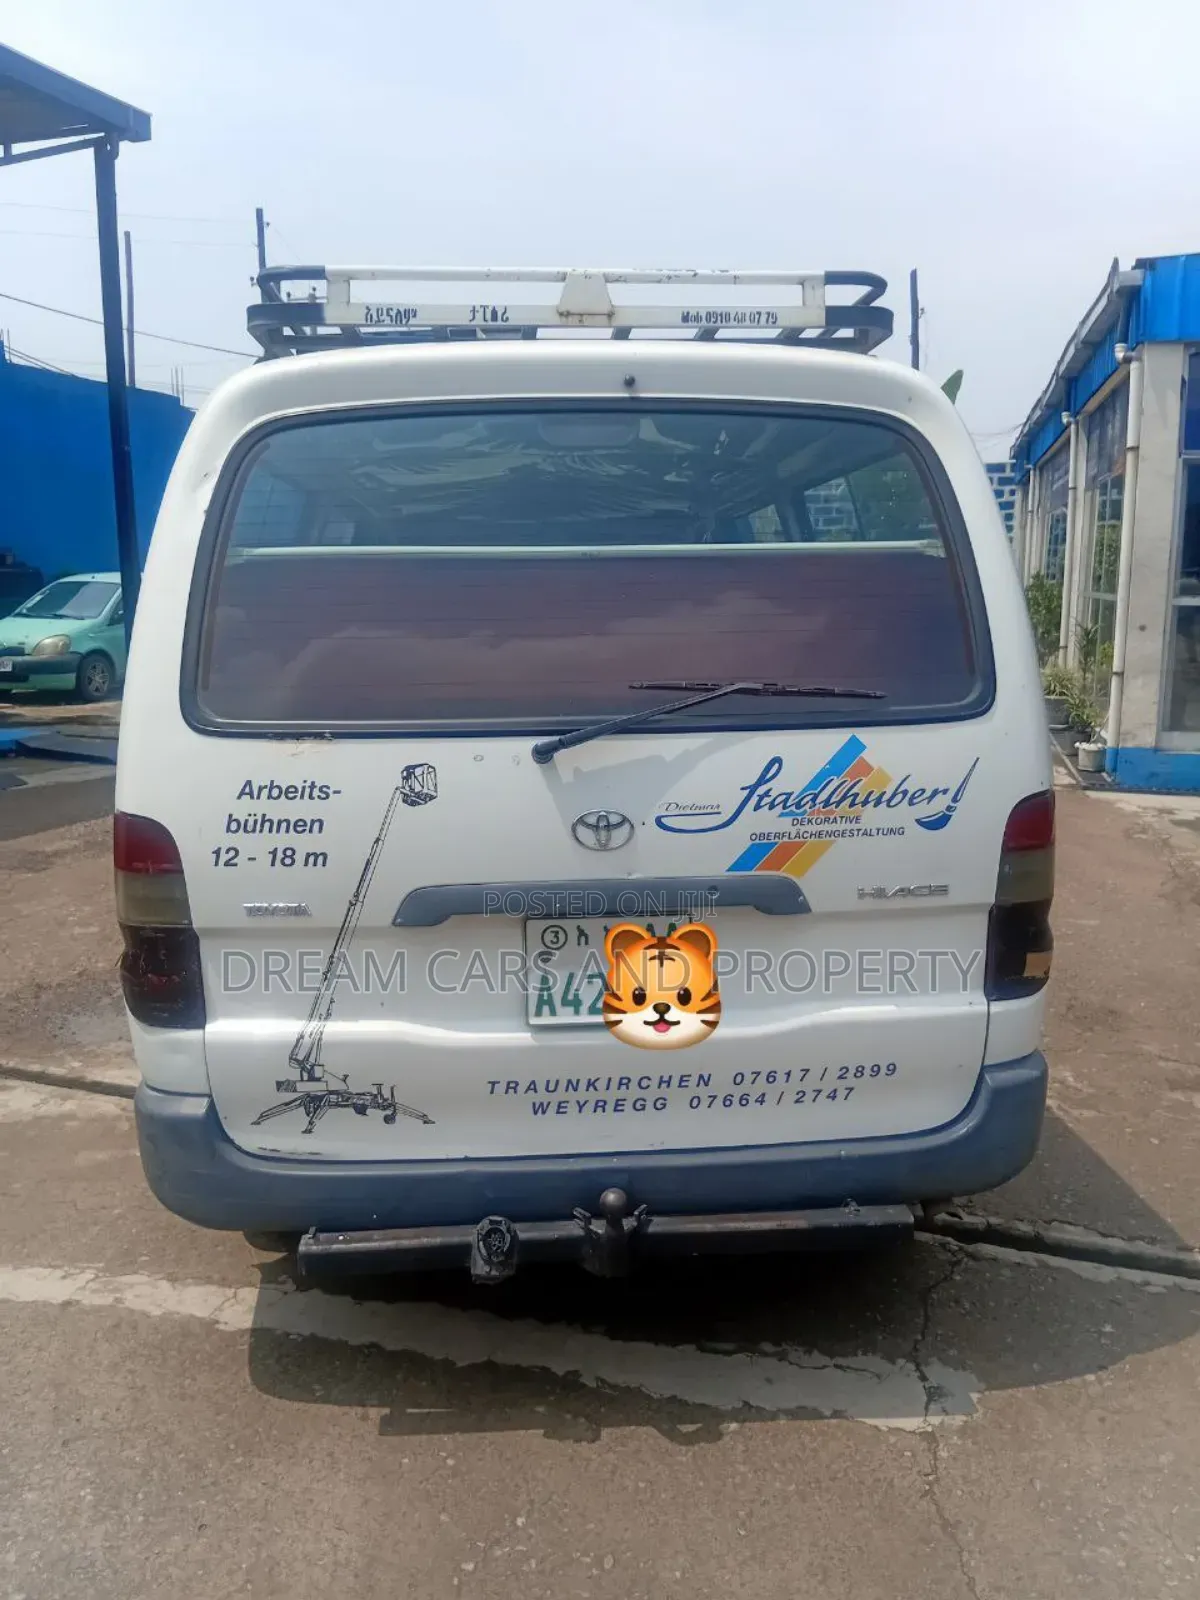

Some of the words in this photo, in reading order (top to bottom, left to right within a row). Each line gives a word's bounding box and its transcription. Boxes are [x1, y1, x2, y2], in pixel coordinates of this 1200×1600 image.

[237, 779, 342, 801] Arbeits-
[225, 813, 325, 835] bühnen
[791, 816, 862, 827] DEKORATIVE
[749, 827, 905, 842] OBERFLÄCHENGESTALTUNG
[211, 847, 239, 868] 12
[268, 847, 296, 868] 18
[304, 852, 328, 868] m
[243, 903, 313, 918] TOYOTA
[487, 1073, 713, 1096] TRAUNKIRCHEN
[733, 1069, 811, 1087] 07617
[838, 1063, 899, 1080] 2899
[532, 1097, 669, 1116] WEYREGG
[689, 1092, 767, 1110] 07664
[794, 1087, 857, 1104] 2747
